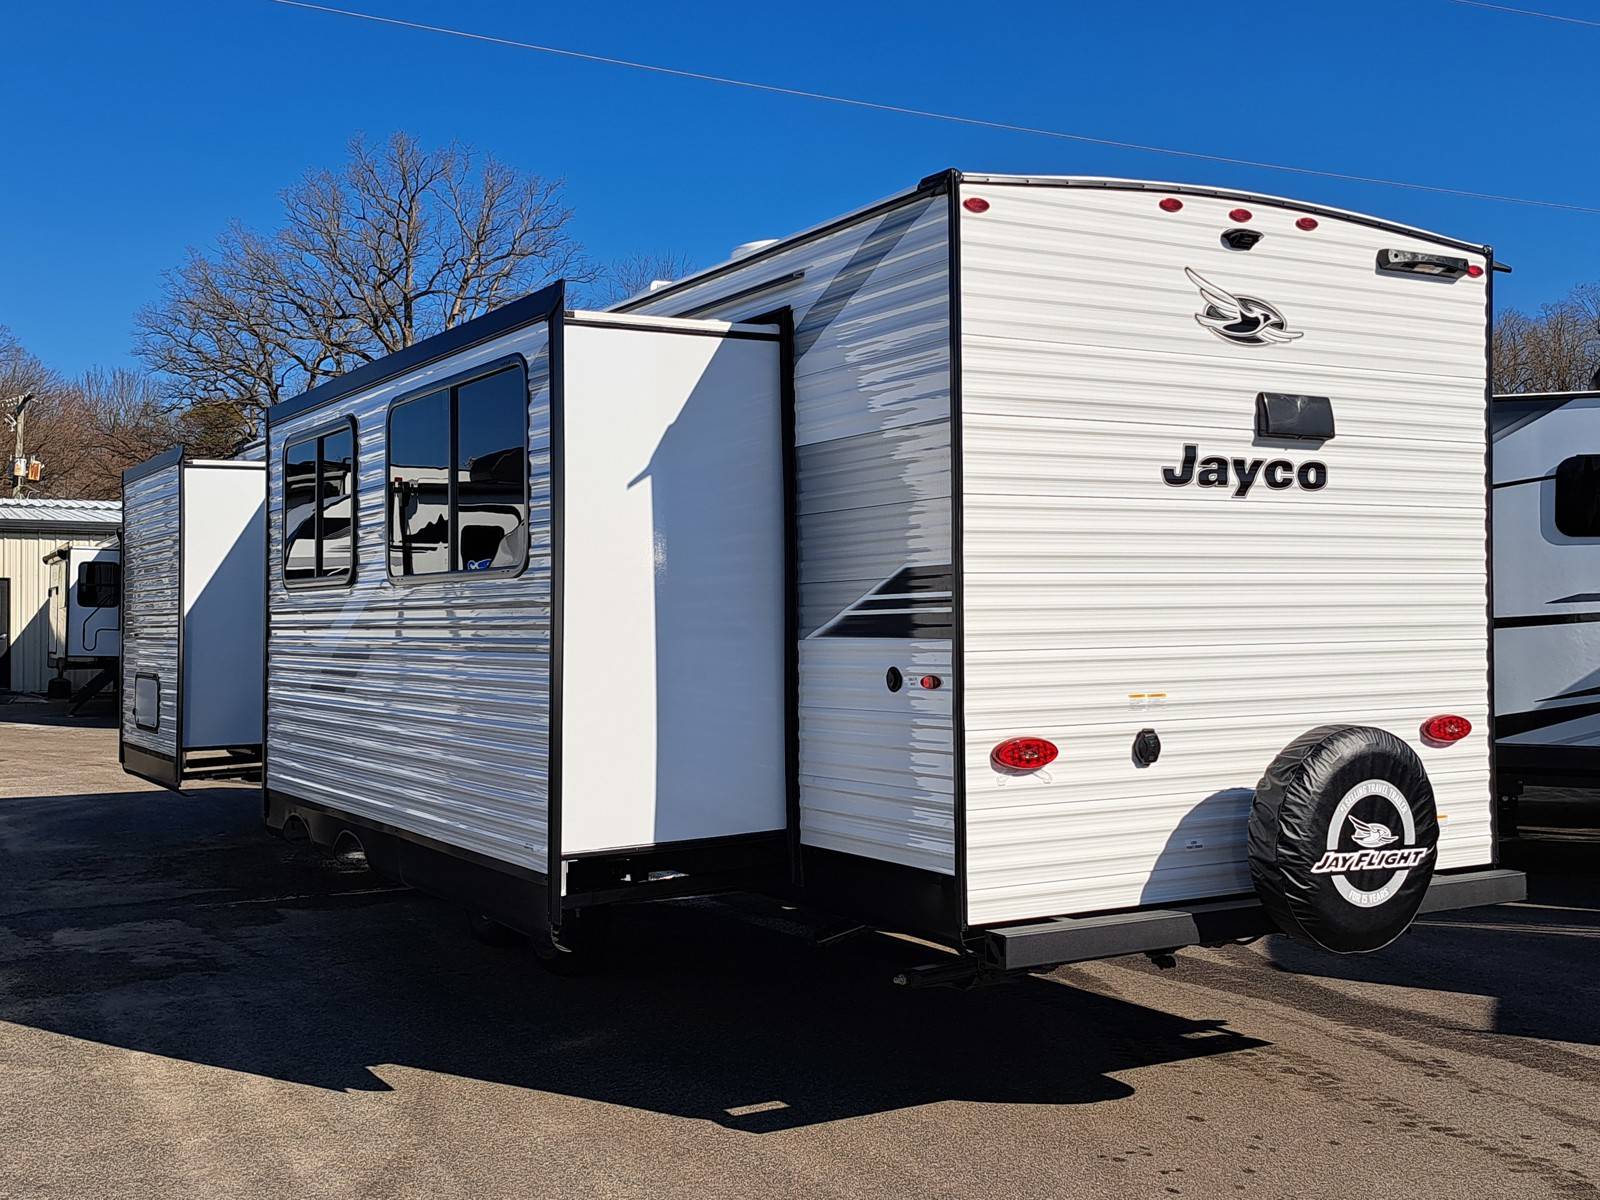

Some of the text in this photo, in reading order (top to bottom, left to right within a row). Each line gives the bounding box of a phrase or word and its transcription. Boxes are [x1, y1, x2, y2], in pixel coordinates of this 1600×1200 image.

[1161, 443, 1328, 499] Jayco
[1345, 785, 1367, 806] SELLING
[1368, 783, 1389, 795] TRAVEL
[1389, 788, 1408, 814] TRAILER
[1348, 890, 1360, 903] FOR
[1368, 887, 1389, 904] YEARS
